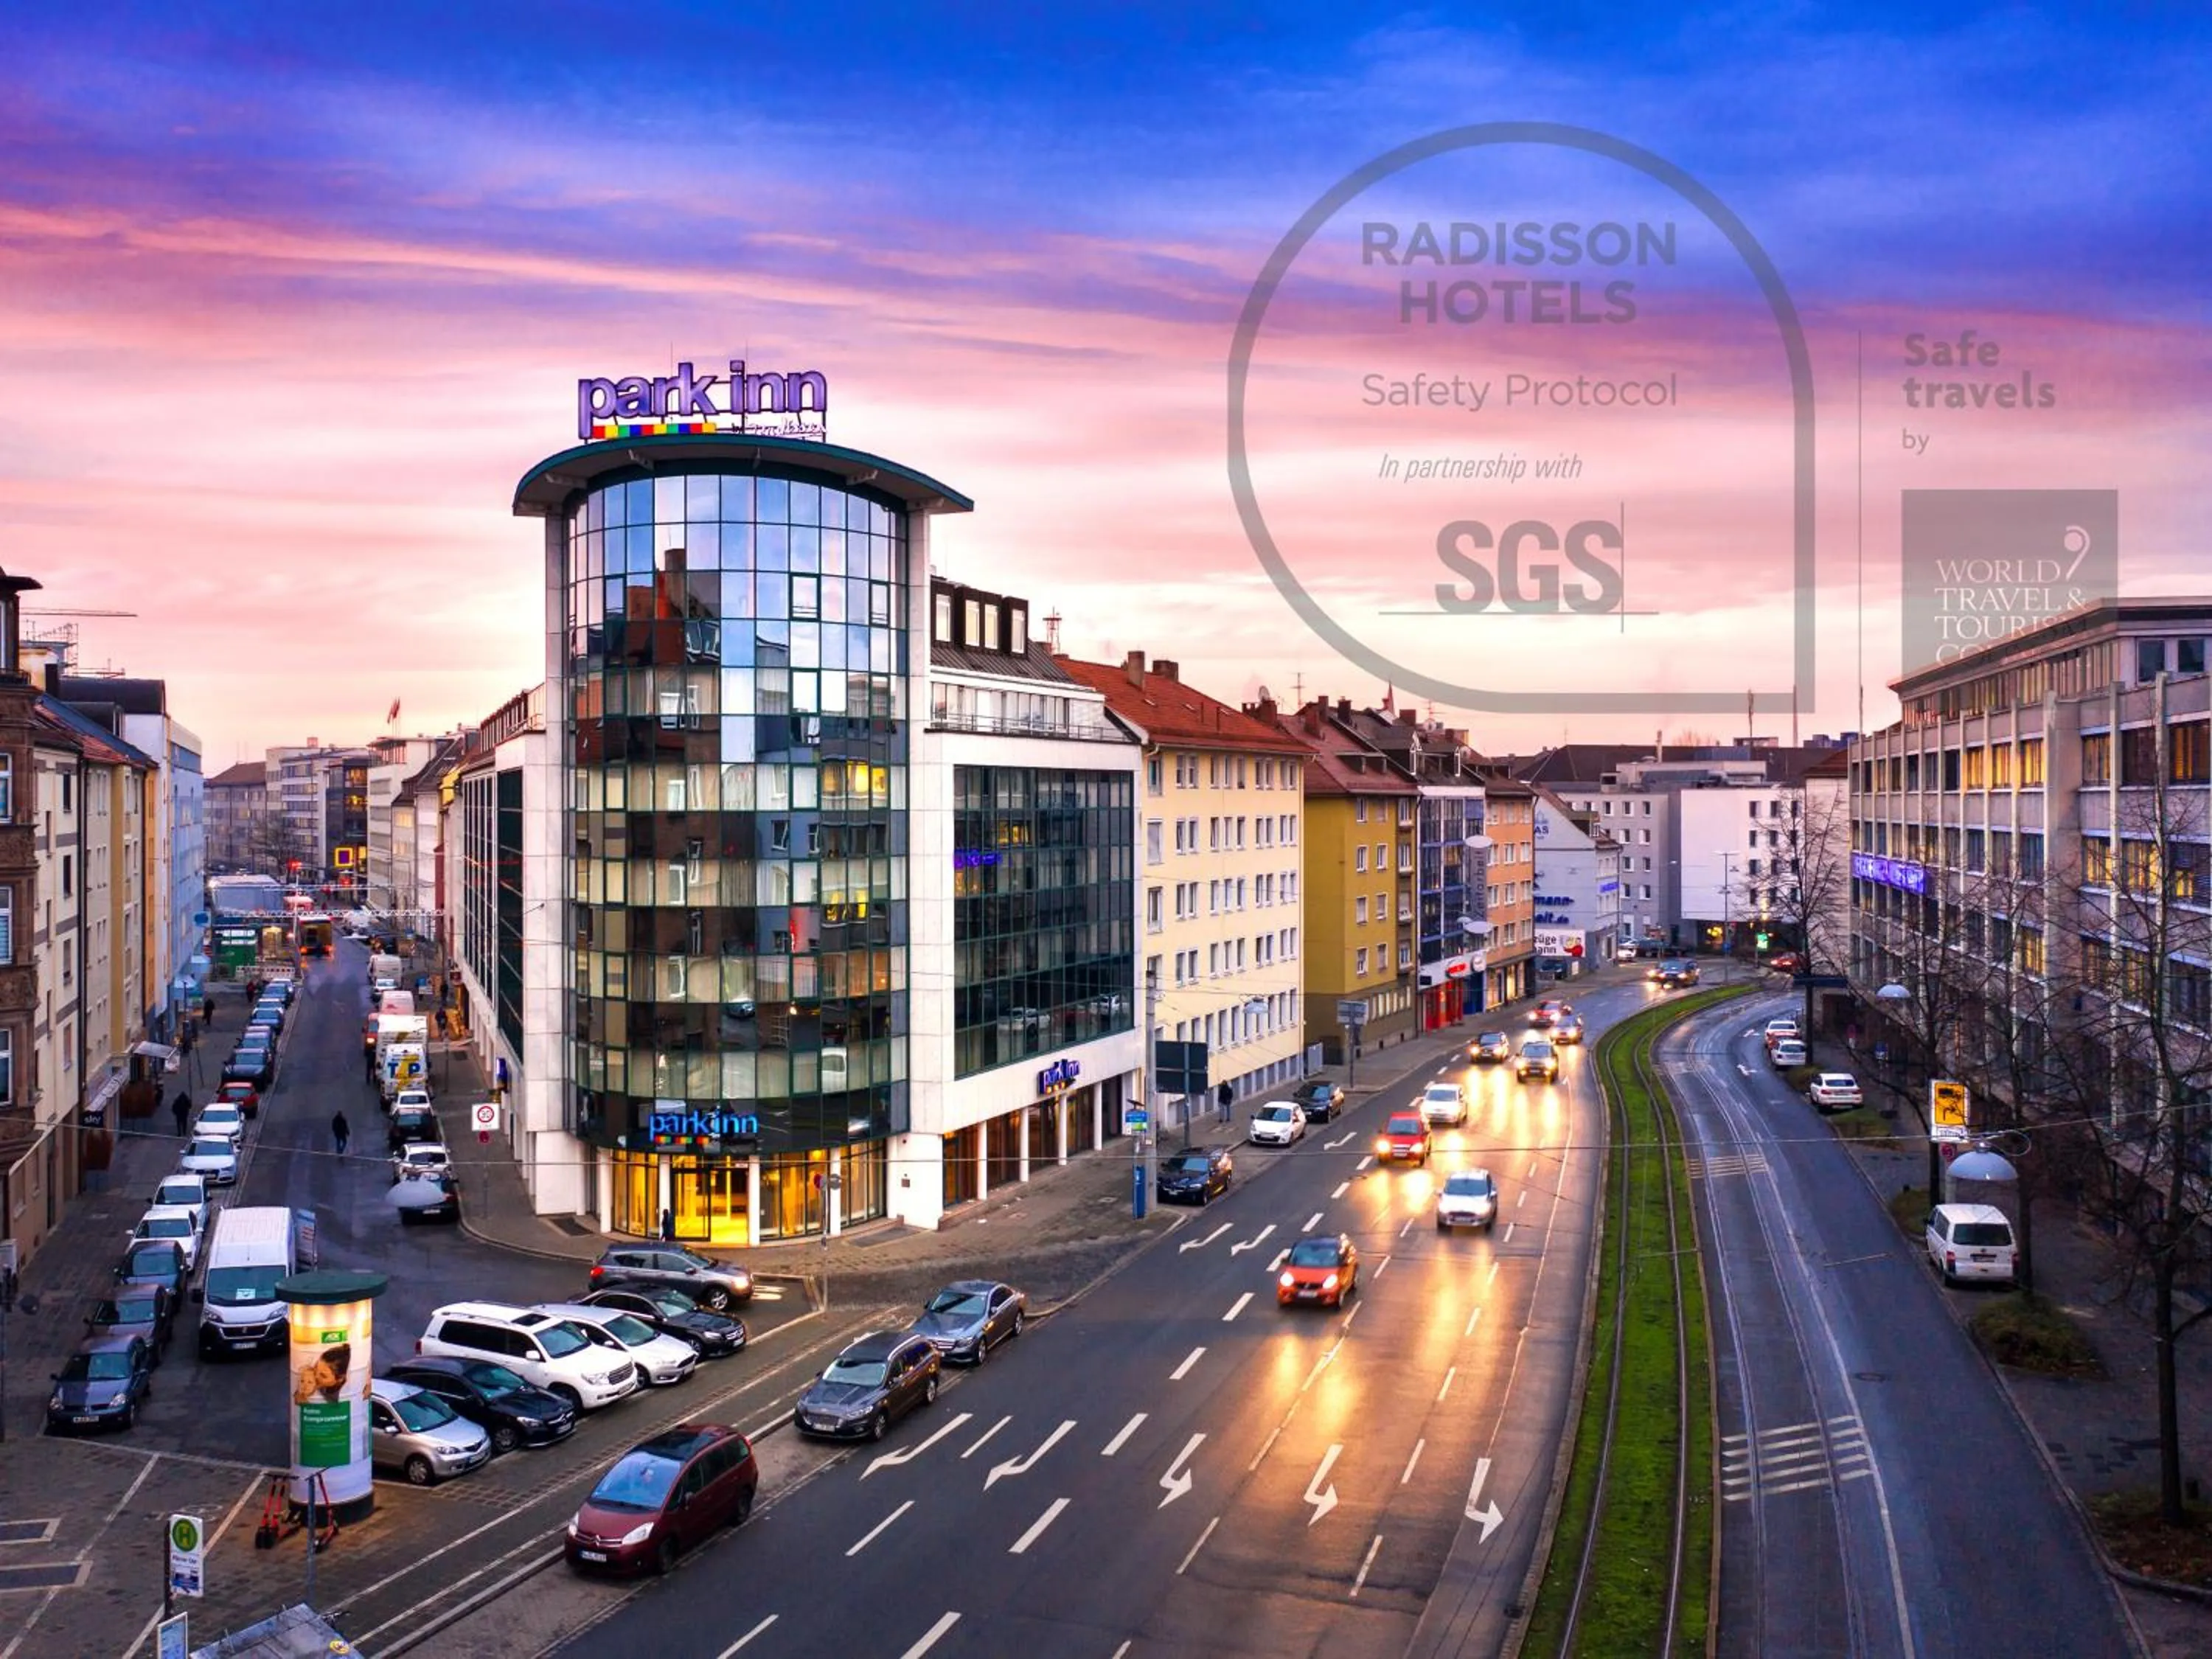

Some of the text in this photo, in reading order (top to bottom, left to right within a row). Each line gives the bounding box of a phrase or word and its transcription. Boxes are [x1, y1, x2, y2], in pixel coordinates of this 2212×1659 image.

[578, 360, 827, 439] park inn
[649, 1110, 710, 1141] park
